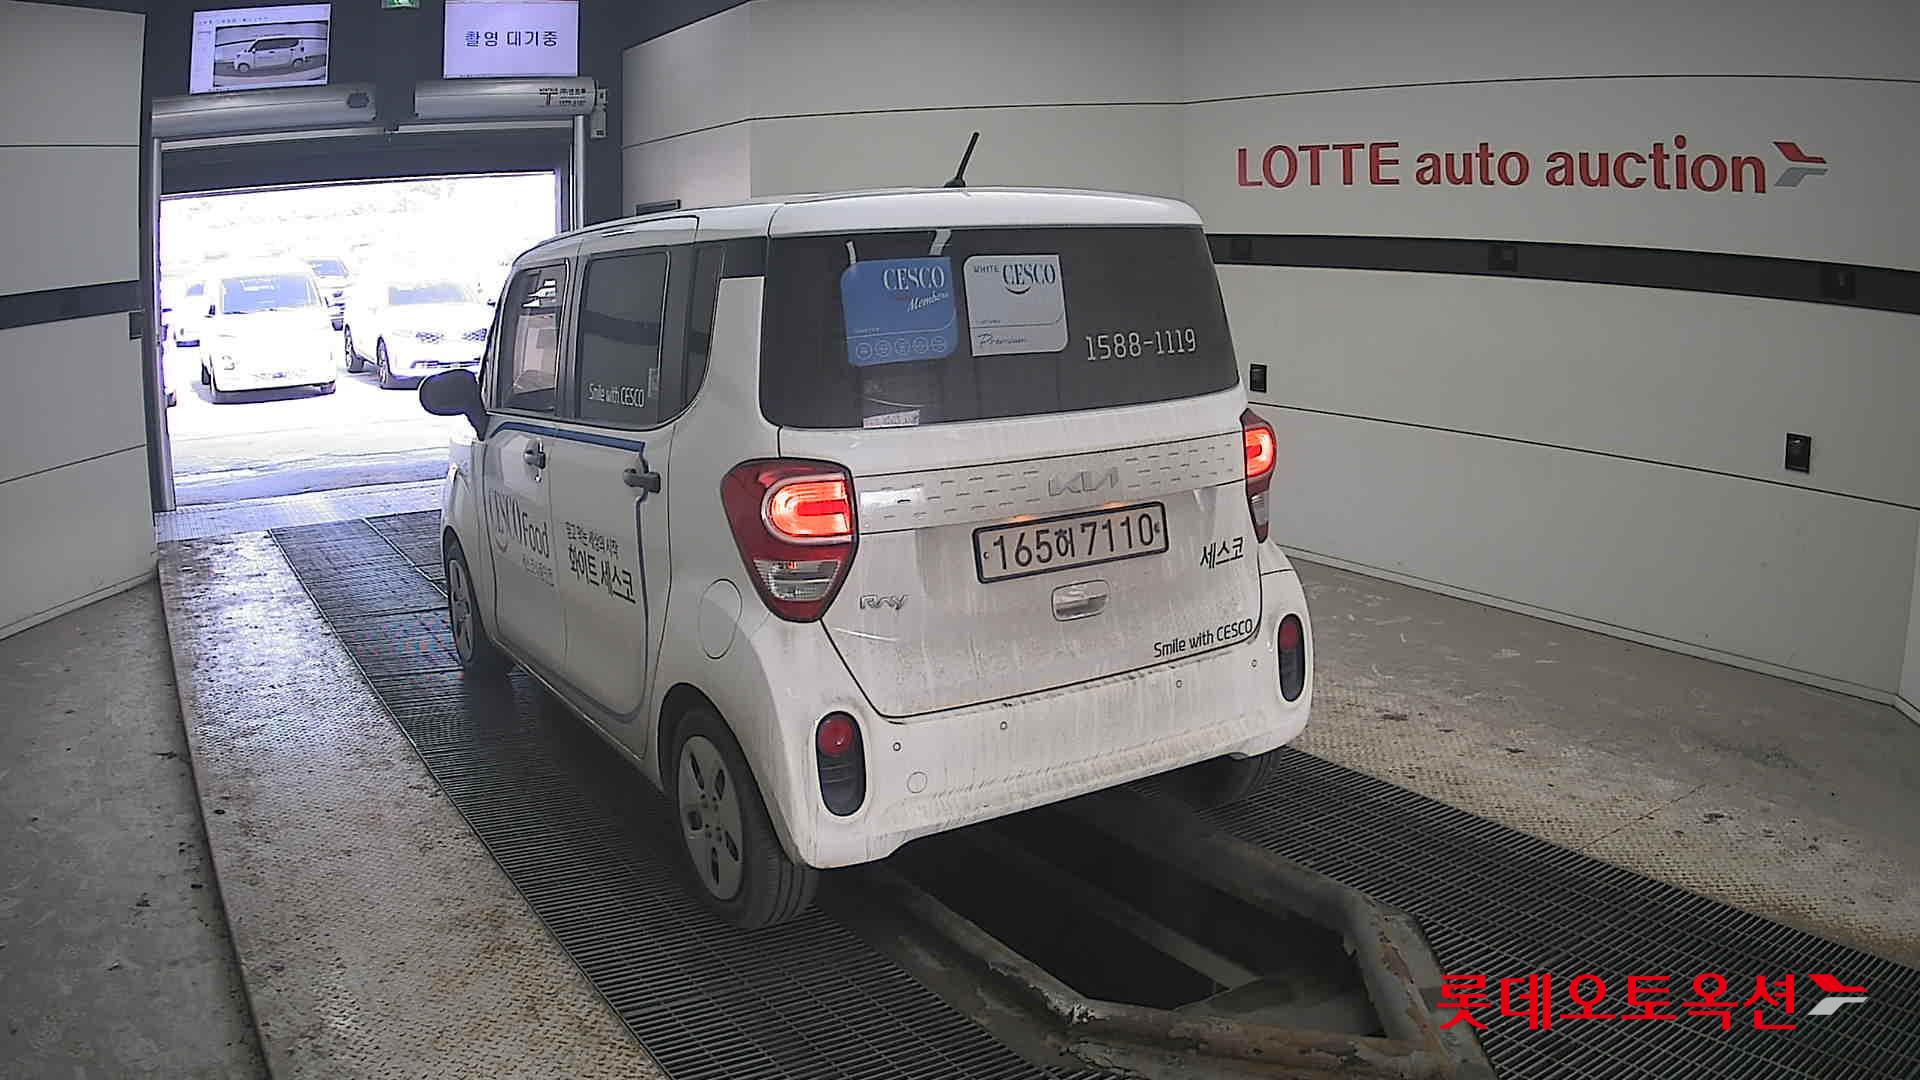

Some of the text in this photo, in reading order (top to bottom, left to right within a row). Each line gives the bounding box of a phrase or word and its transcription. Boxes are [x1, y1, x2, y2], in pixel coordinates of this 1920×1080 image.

[465, 31, 499, 47] 촬영
[1236, 134, 1767, 194] LOTTE auto auction
[883, 265, 945, 290] CESCO
[1003, 263, 1056, 285] CESCO
[1086, 328, 1197, 361] 1588-1119
[620, 386, 645, 408] CESCO
[1200, 536, 1244, 569] 세스코
[600, 559, 637, 605] 세스코
[1153, 618, 1253, 658] Smile with CESCO
